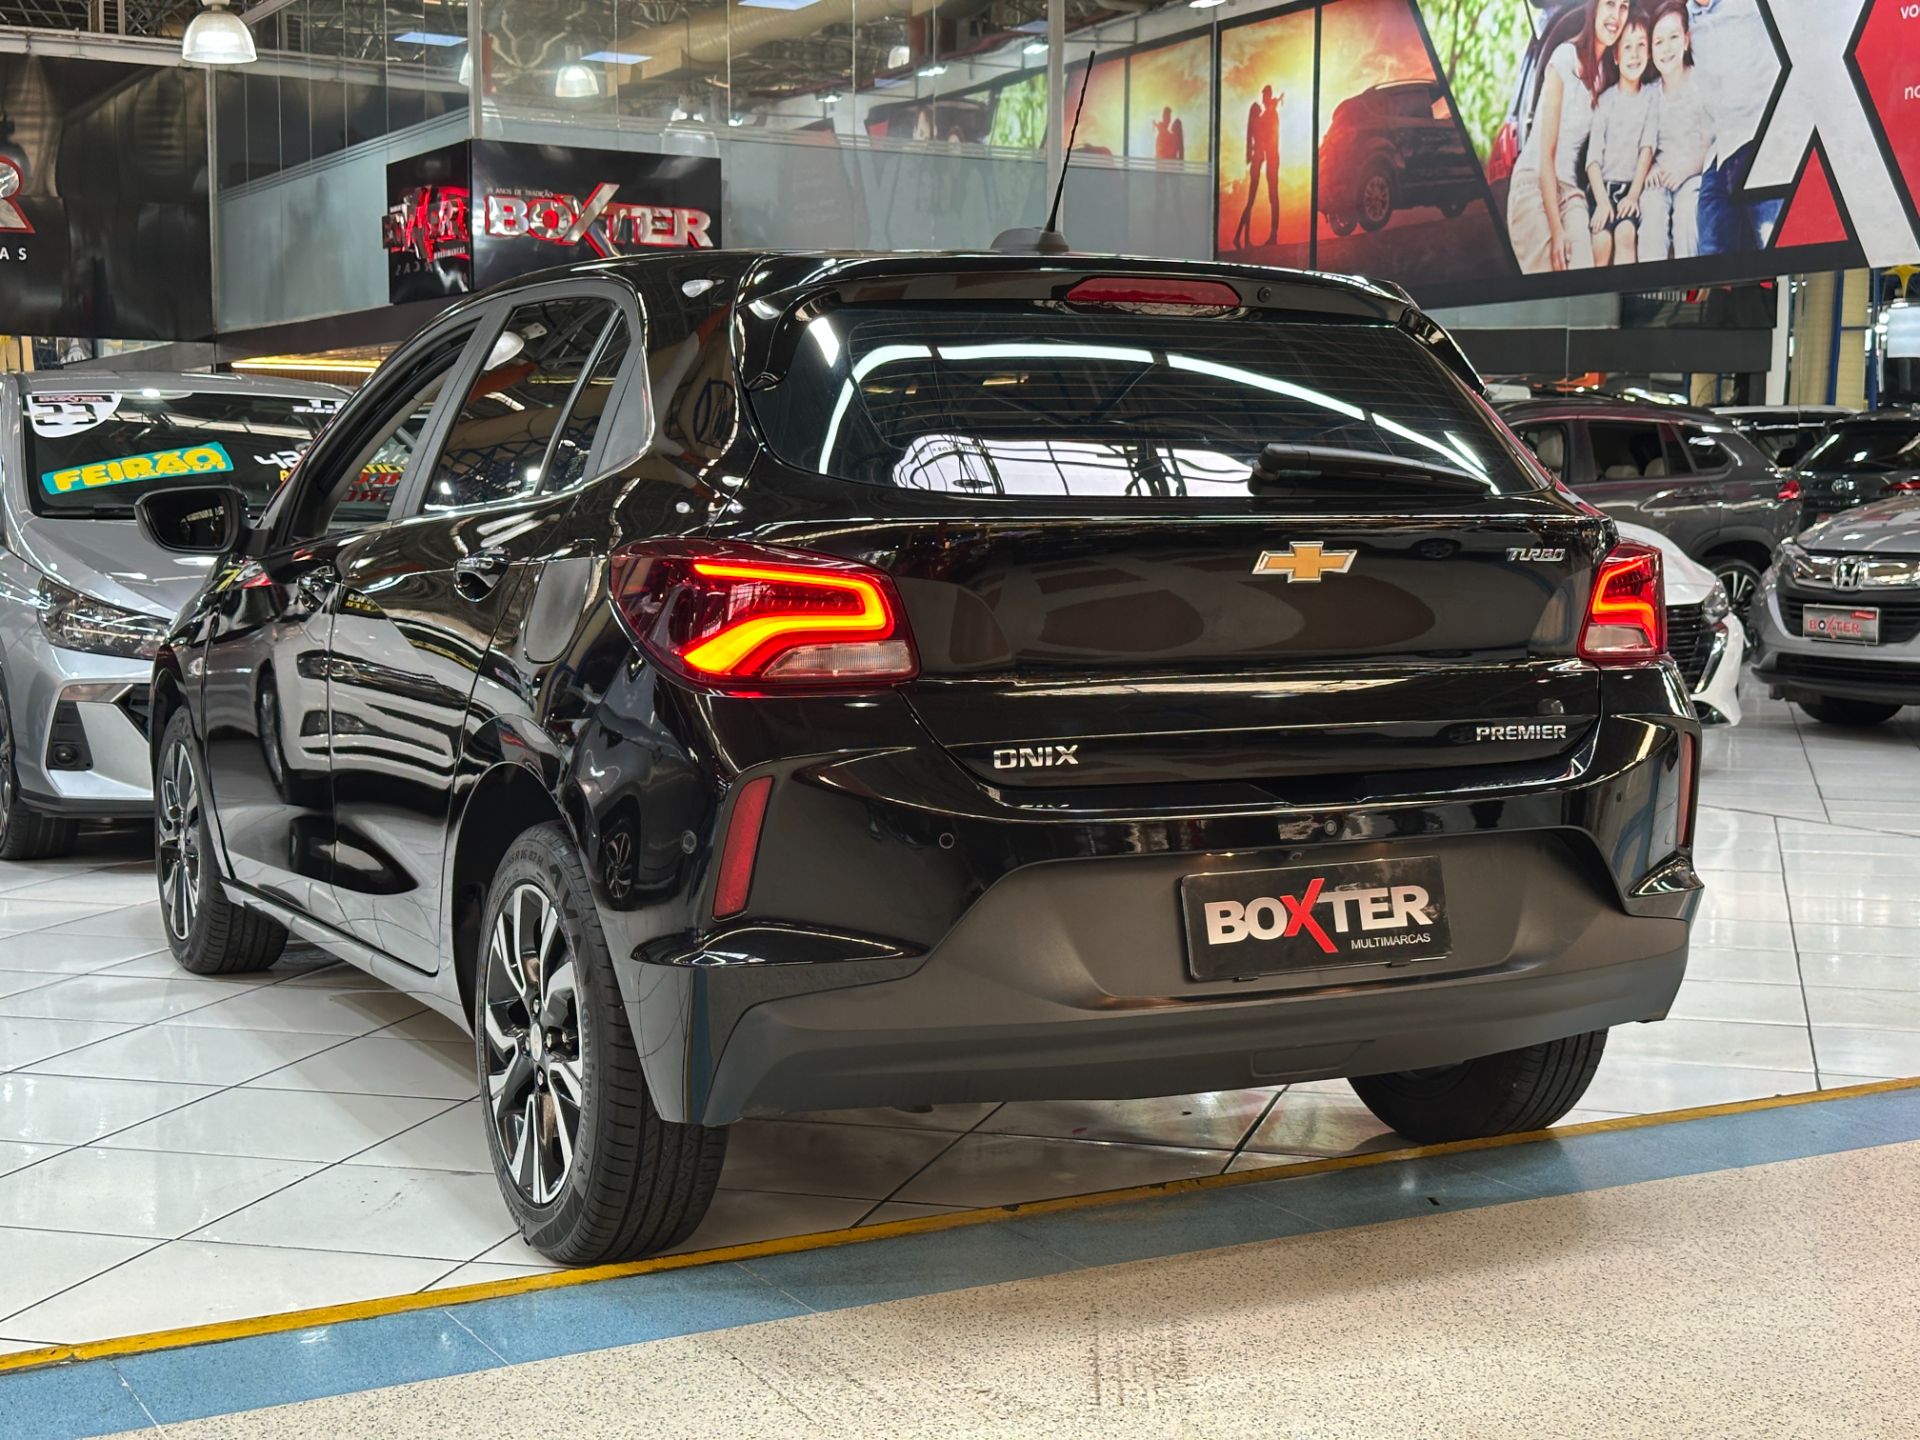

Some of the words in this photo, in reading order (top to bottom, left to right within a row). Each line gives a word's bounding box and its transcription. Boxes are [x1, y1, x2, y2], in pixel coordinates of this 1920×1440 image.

[1900, 4, 1920, 19] vo
[485, 182, 715, 258] BOXTER
[53, 447, 226, 492] FEIRÃO
[1506, 547, 1565, 562] TURBO
[1807, 615, 1862, 640] BOXTER
[1476, 724, 1567, 742] PREMIER
[993, 744, 1079, 770] ONIX
[1204, 877, 1434, 954] BOXTER
[1351, 932, 1431, 950] MULTIMARCAS
